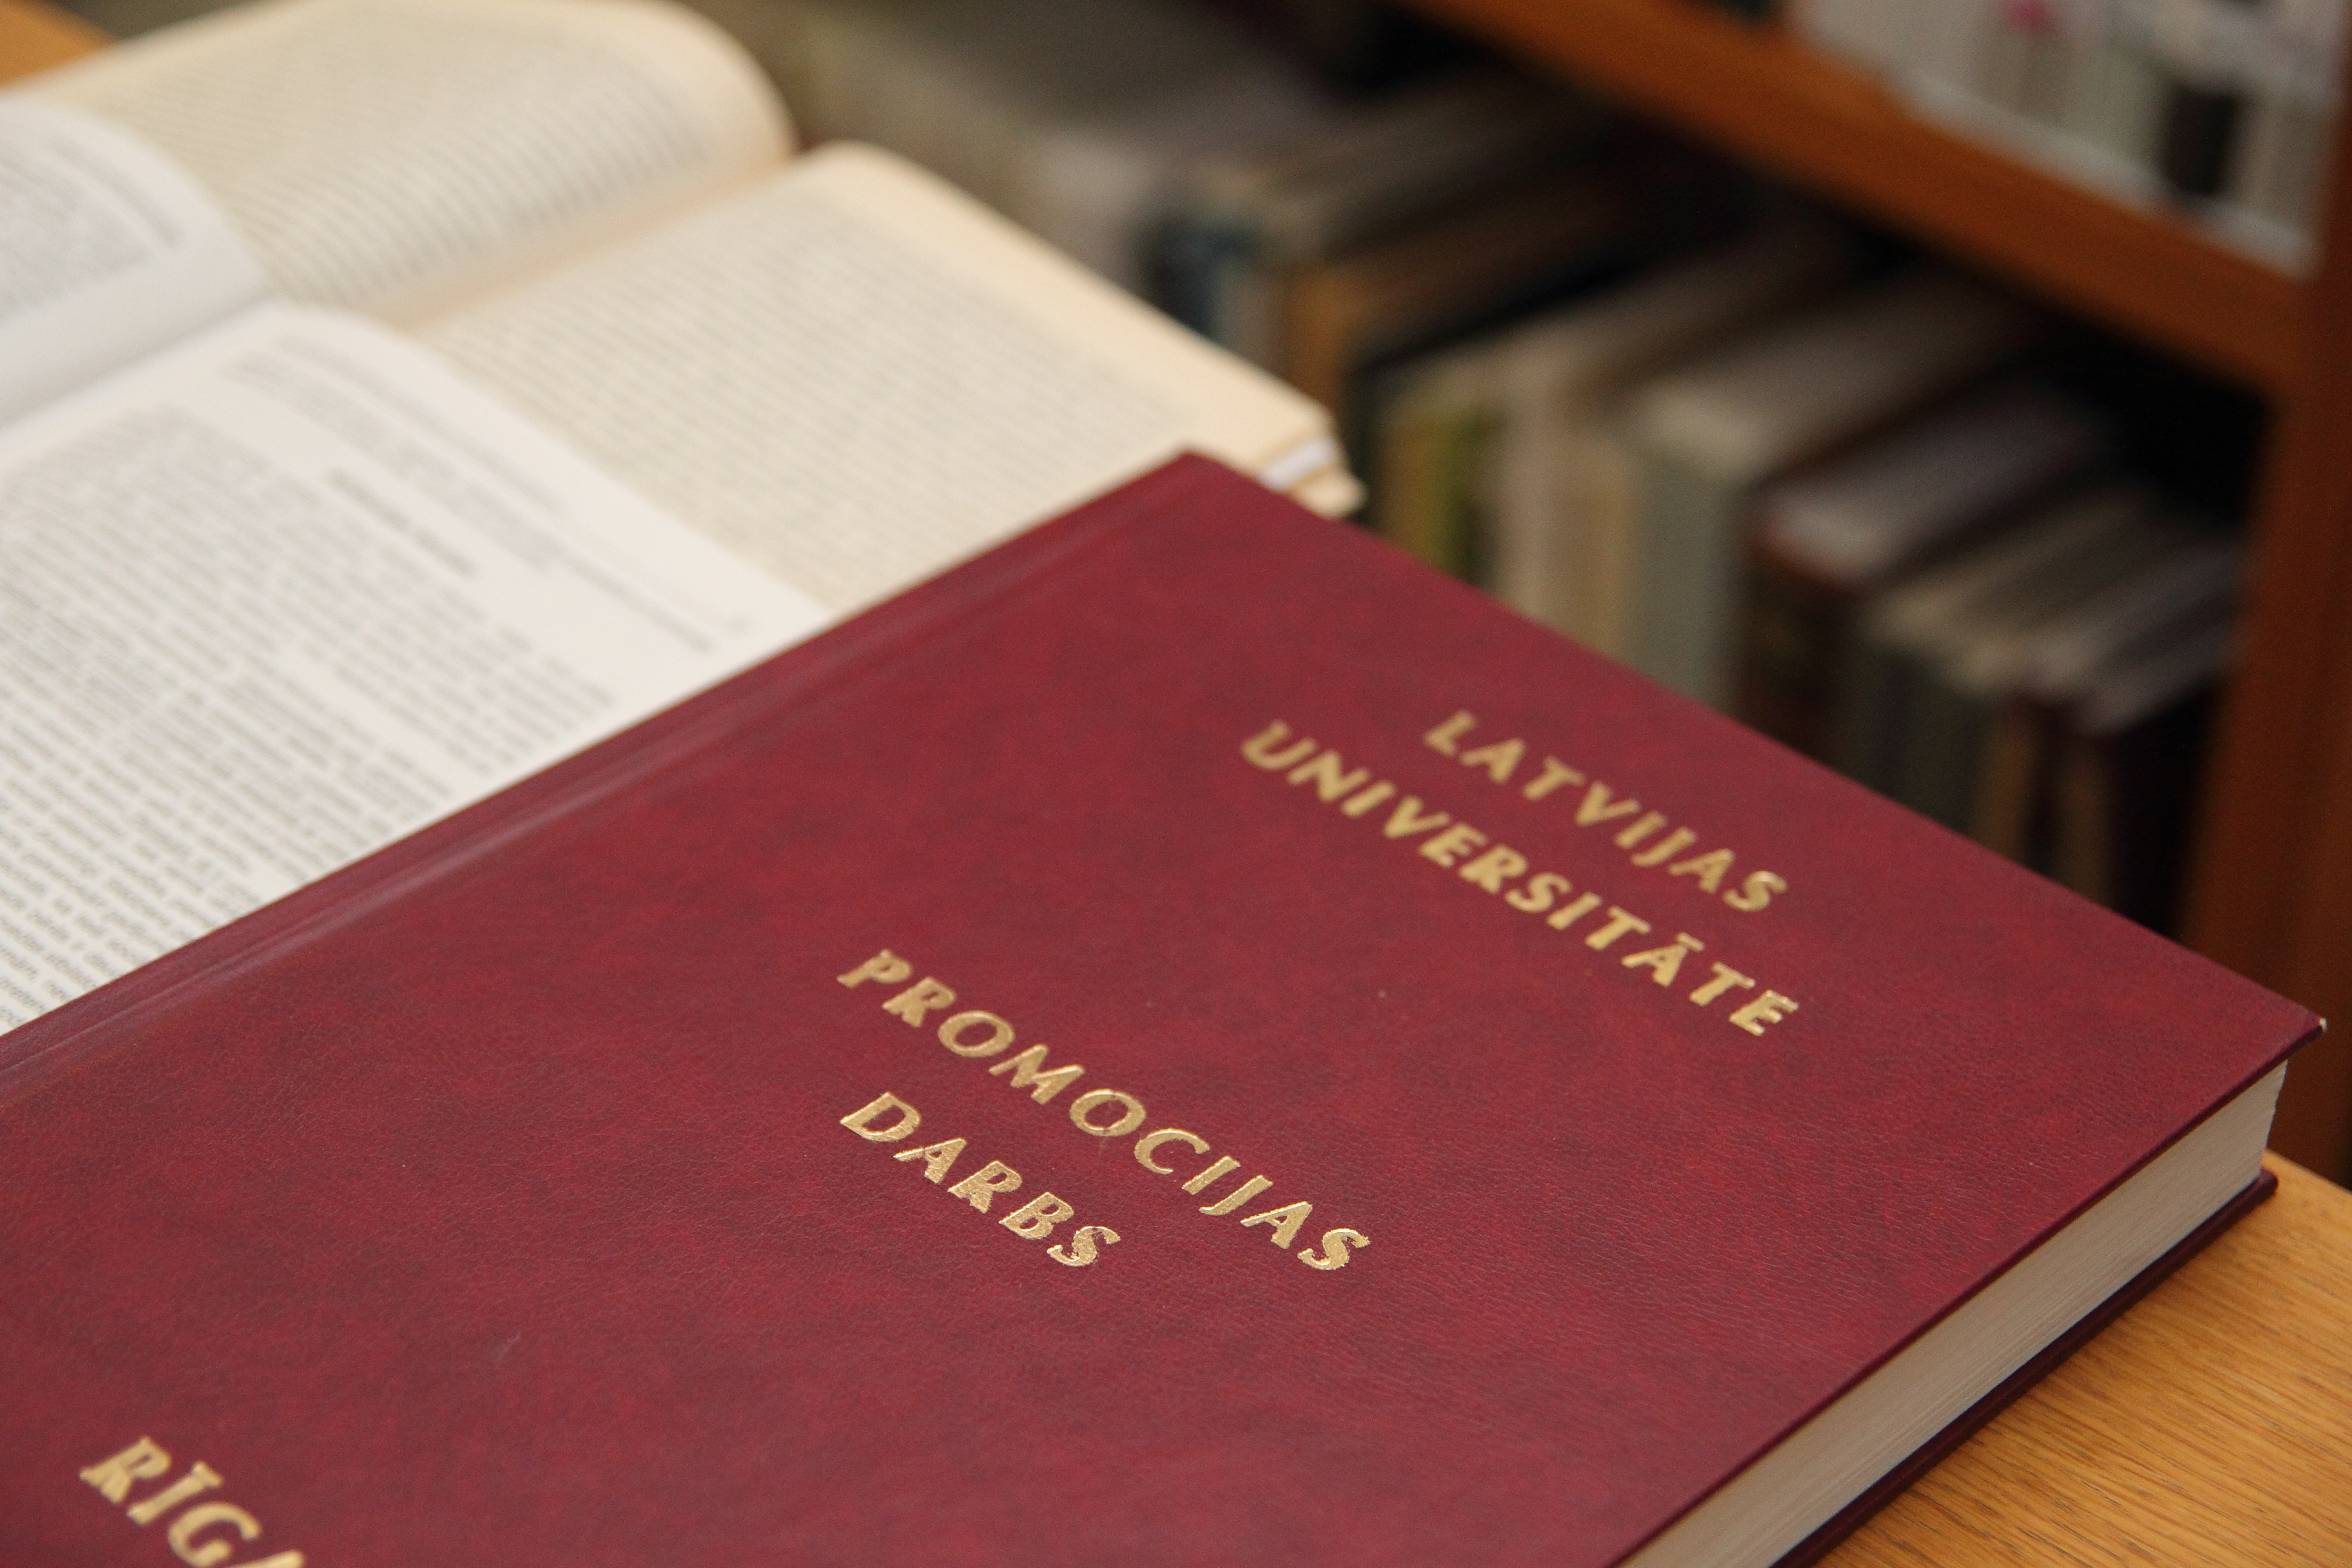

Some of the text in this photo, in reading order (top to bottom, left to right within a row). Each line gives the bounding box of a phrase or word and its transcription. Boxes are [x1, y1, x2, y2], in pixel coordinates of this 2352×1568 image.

[1242, 723, 1799, 1037] UNIVERSITĀTE
[1425, 712, 1786, 912] LATVIJAS
[837, 949, 1371, 1271] PROMOCIJAS
[839, 1091, 1122, 1267] DARBS
